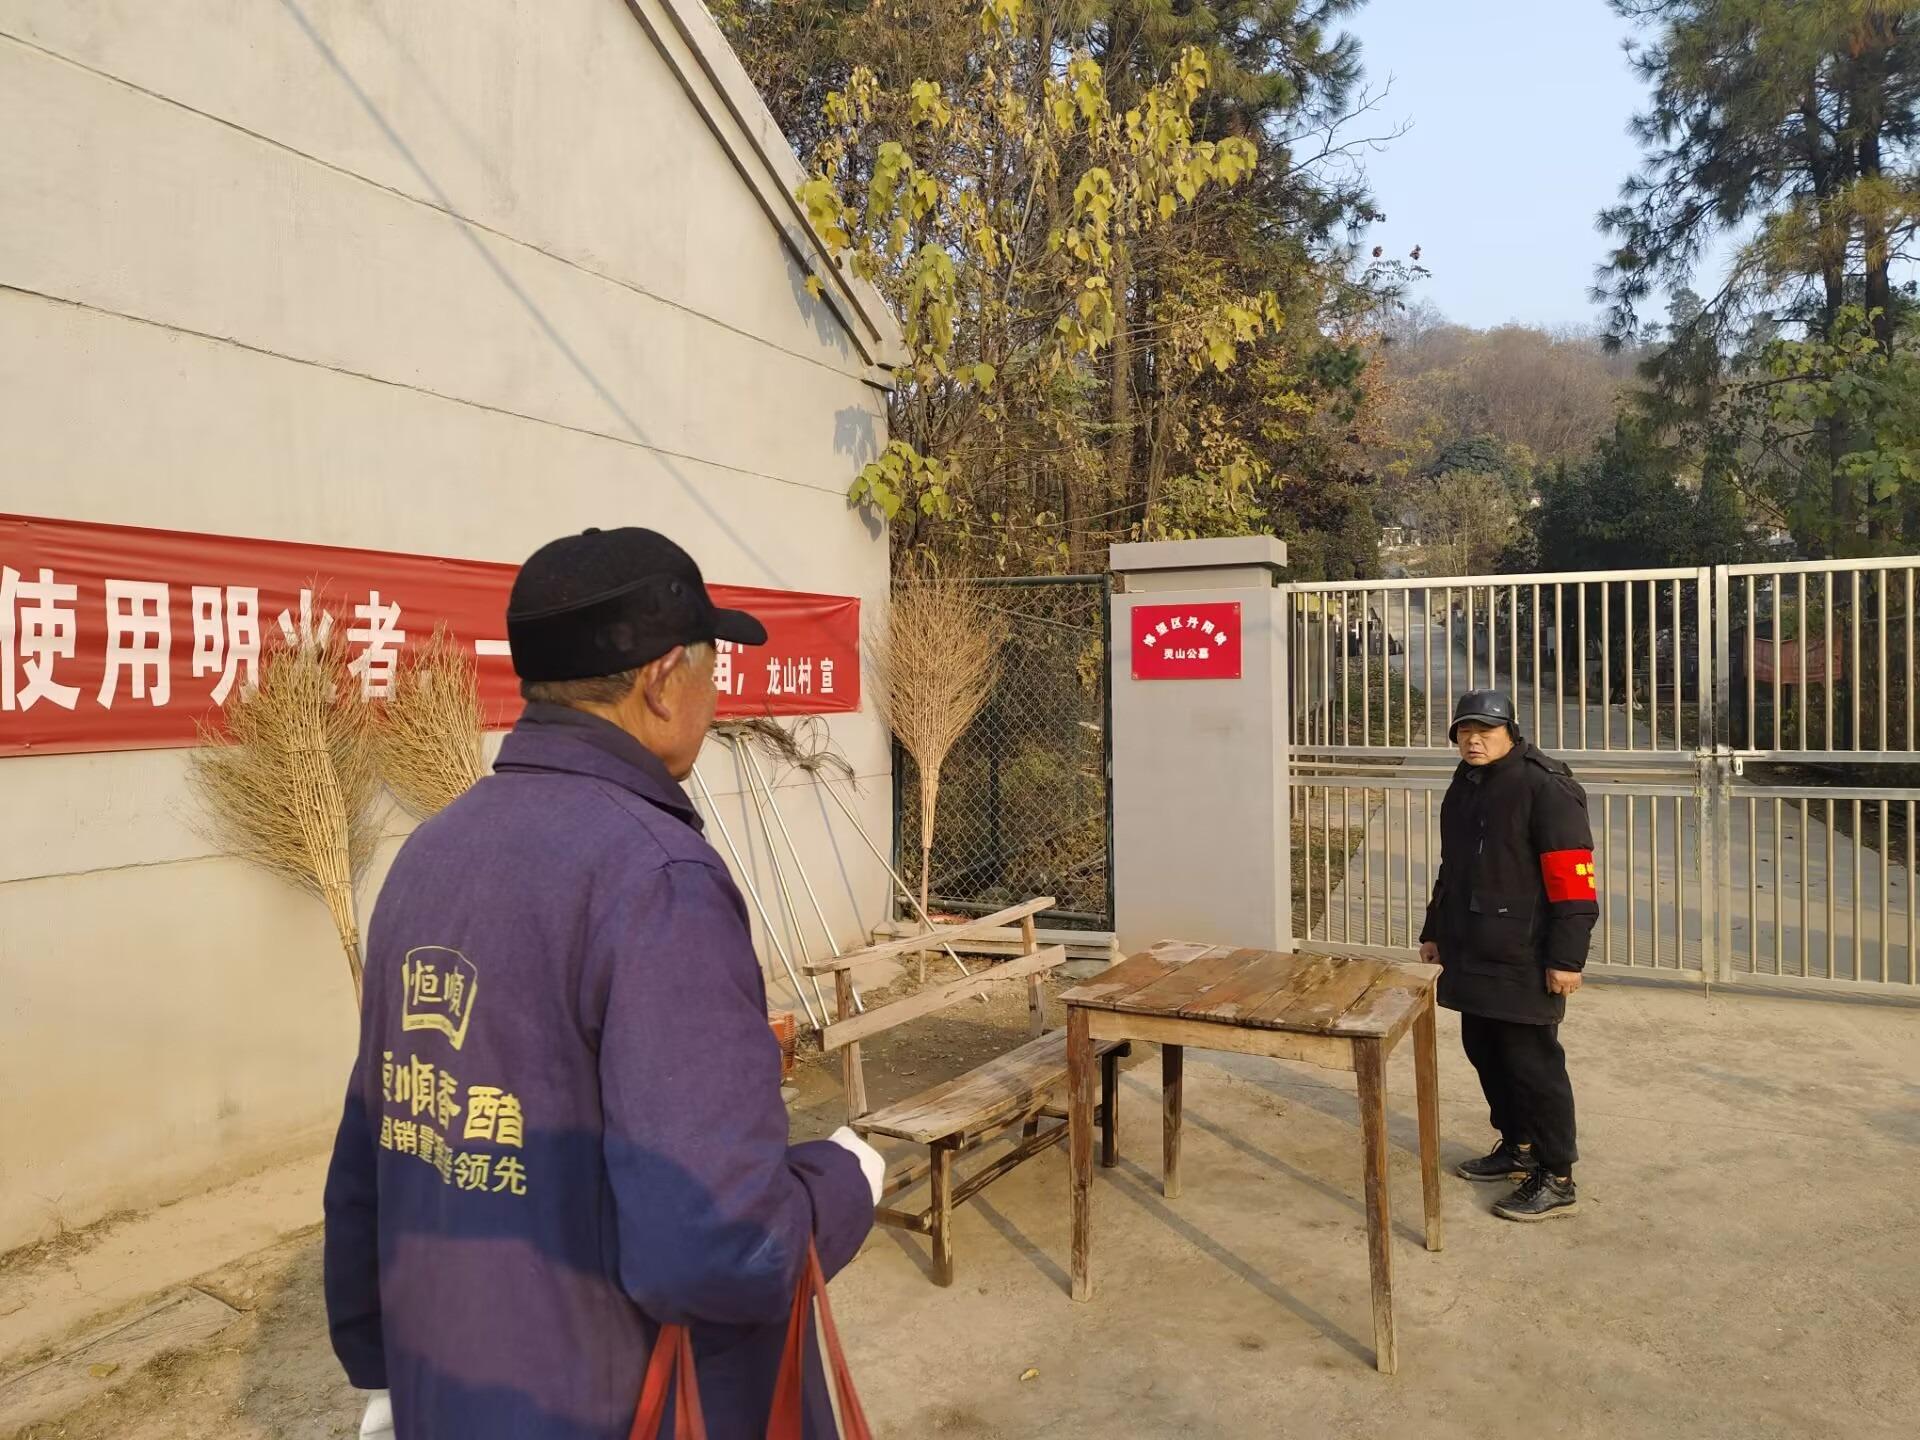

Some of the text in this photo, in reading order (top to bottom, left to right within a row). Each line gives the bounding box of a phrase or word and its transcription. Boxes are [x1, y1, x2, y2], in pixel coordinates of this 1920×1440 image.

[766, 657, 812, 695] 龙山村
[820, 658, 835, 694] 宣
